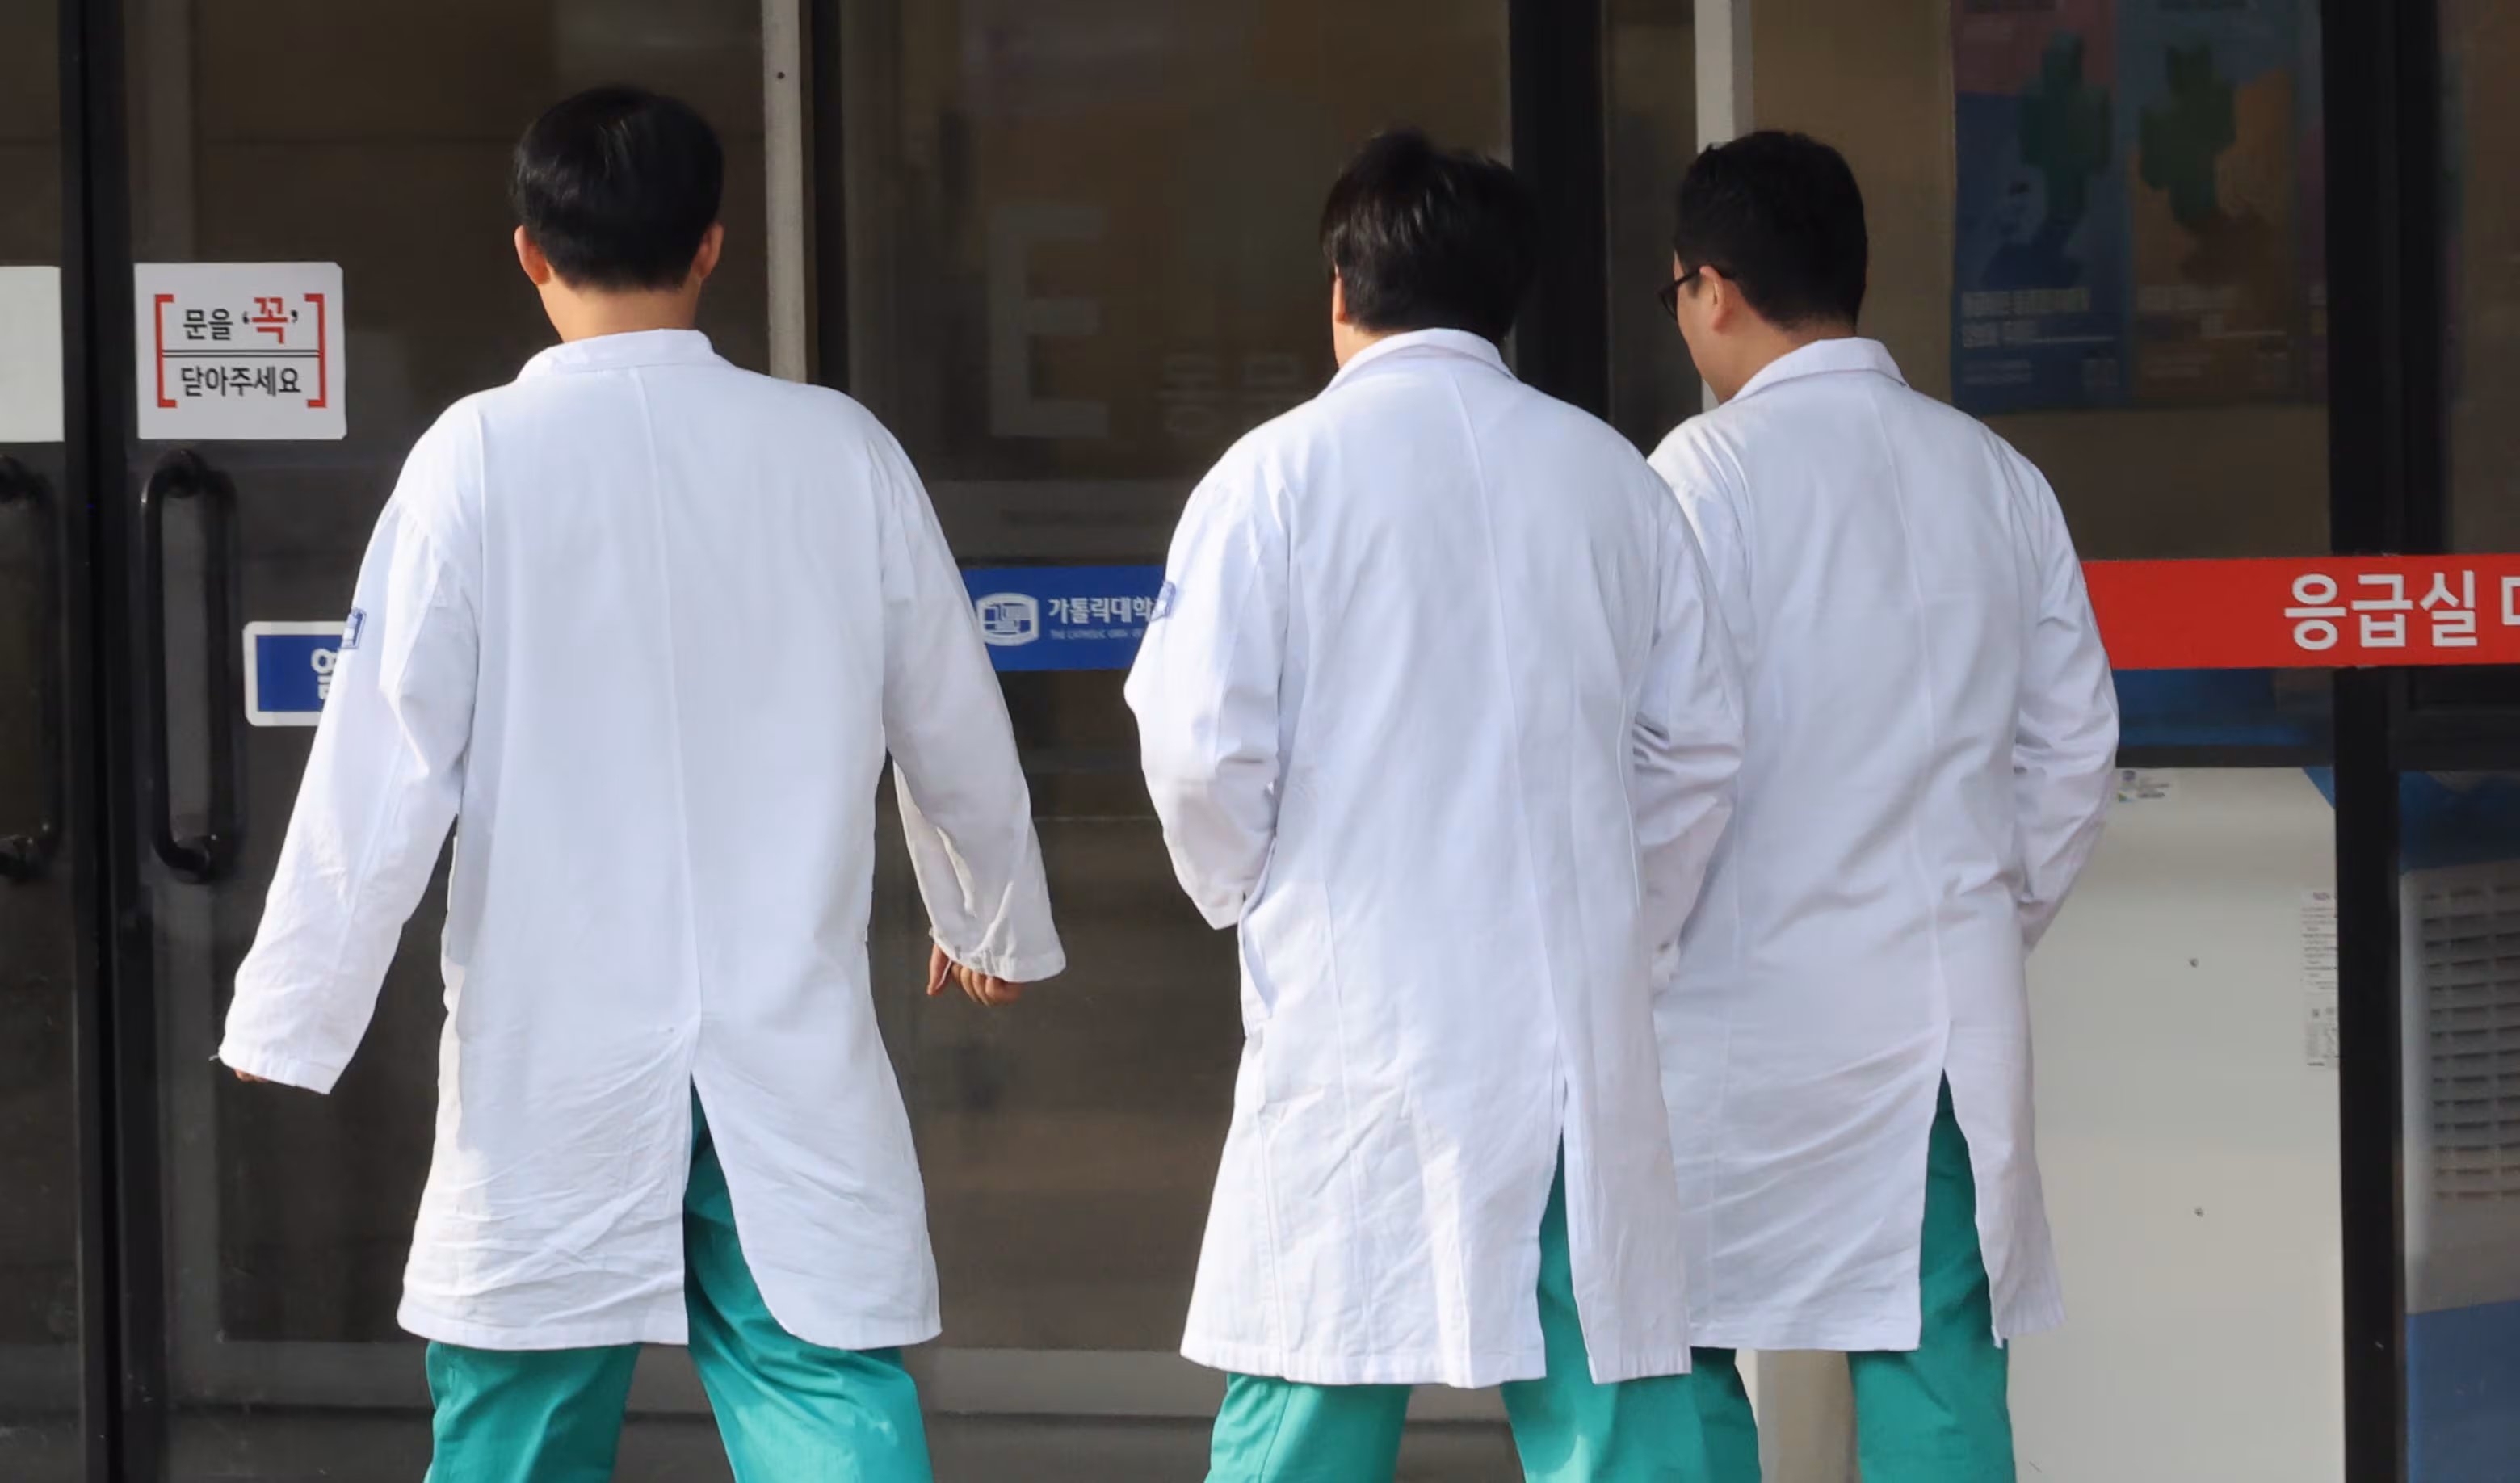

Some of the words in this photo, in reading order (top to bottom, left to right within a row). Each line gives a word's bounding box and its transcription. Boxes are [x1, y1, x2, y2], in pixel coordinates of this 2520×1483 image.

[183, 308, 233, 341] 문을
[989, 205, 1109, 438] E
[180, 365, 302, 397] 닫아주세요
[2283, 569, 2478, 650] 응급실
